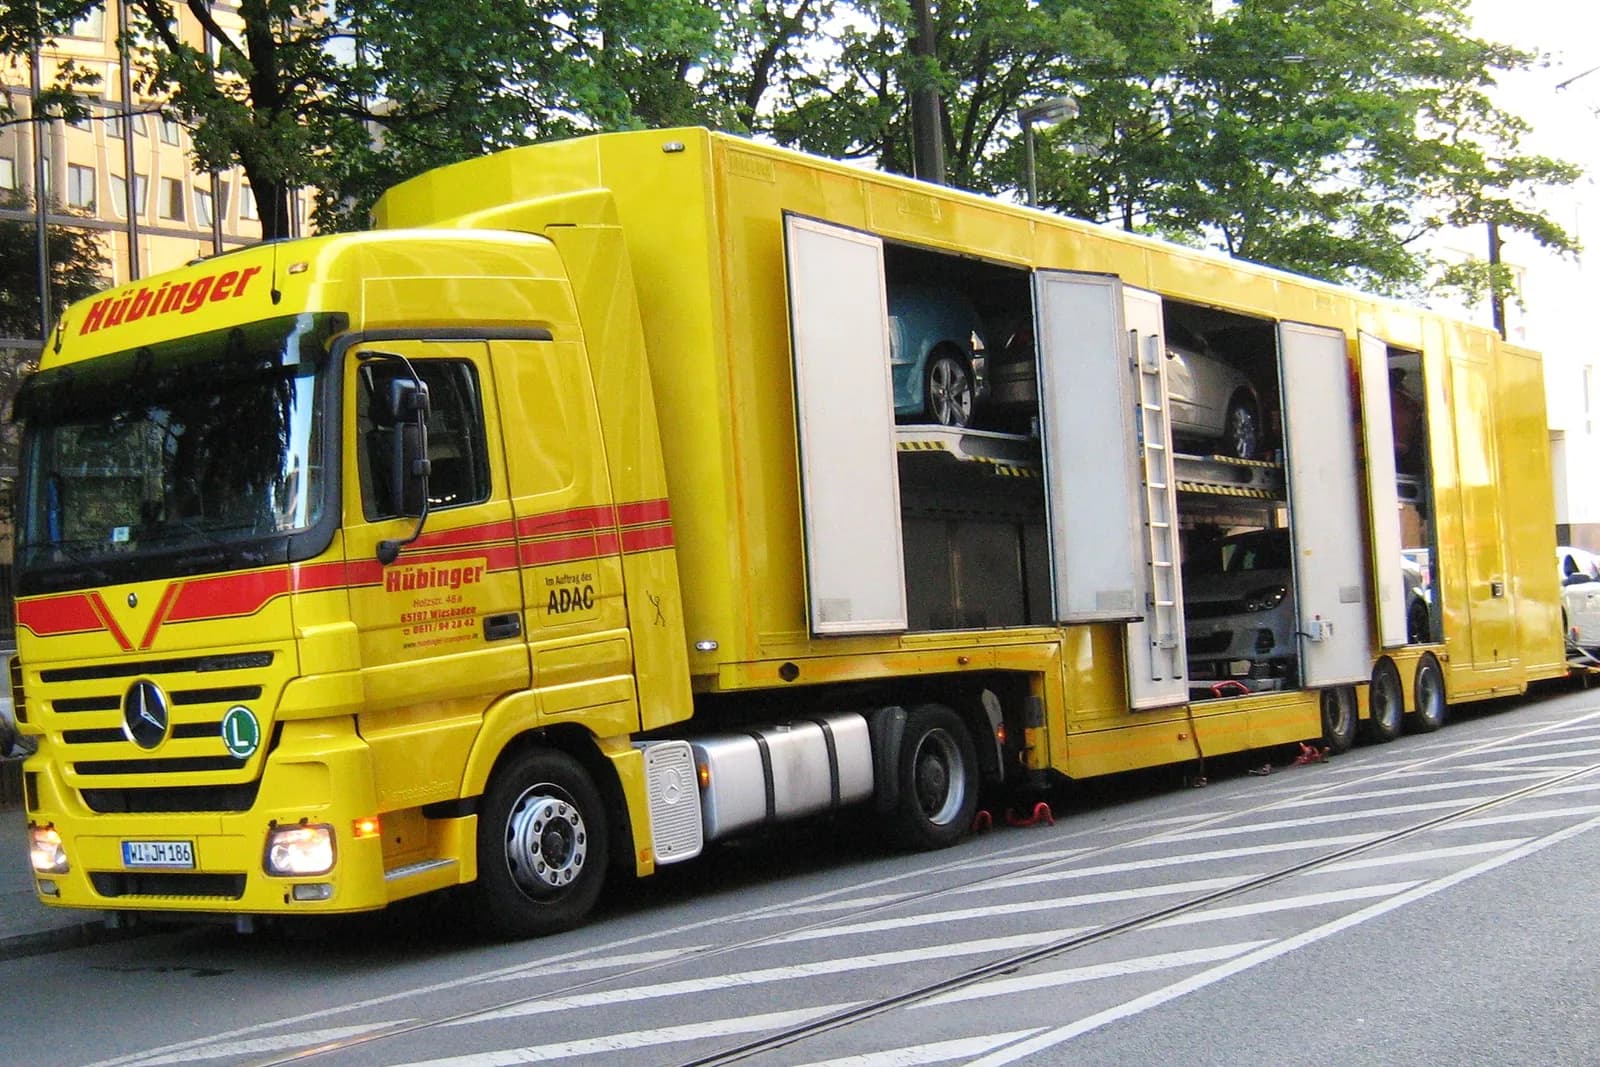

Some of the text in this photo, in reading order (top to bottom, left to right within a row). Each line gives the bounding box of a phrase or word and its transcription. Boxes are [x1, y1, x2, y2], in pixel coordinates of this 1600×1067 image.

[79, 266, 262, 336] Hübinger
[386, 565, 483, 592] Hübinger
[581, 572, 593, 582] des
[547, 584, 595, 615] ADAC
[400, 611, 428, 623] 65197
[232, 717, 249, 747] L
